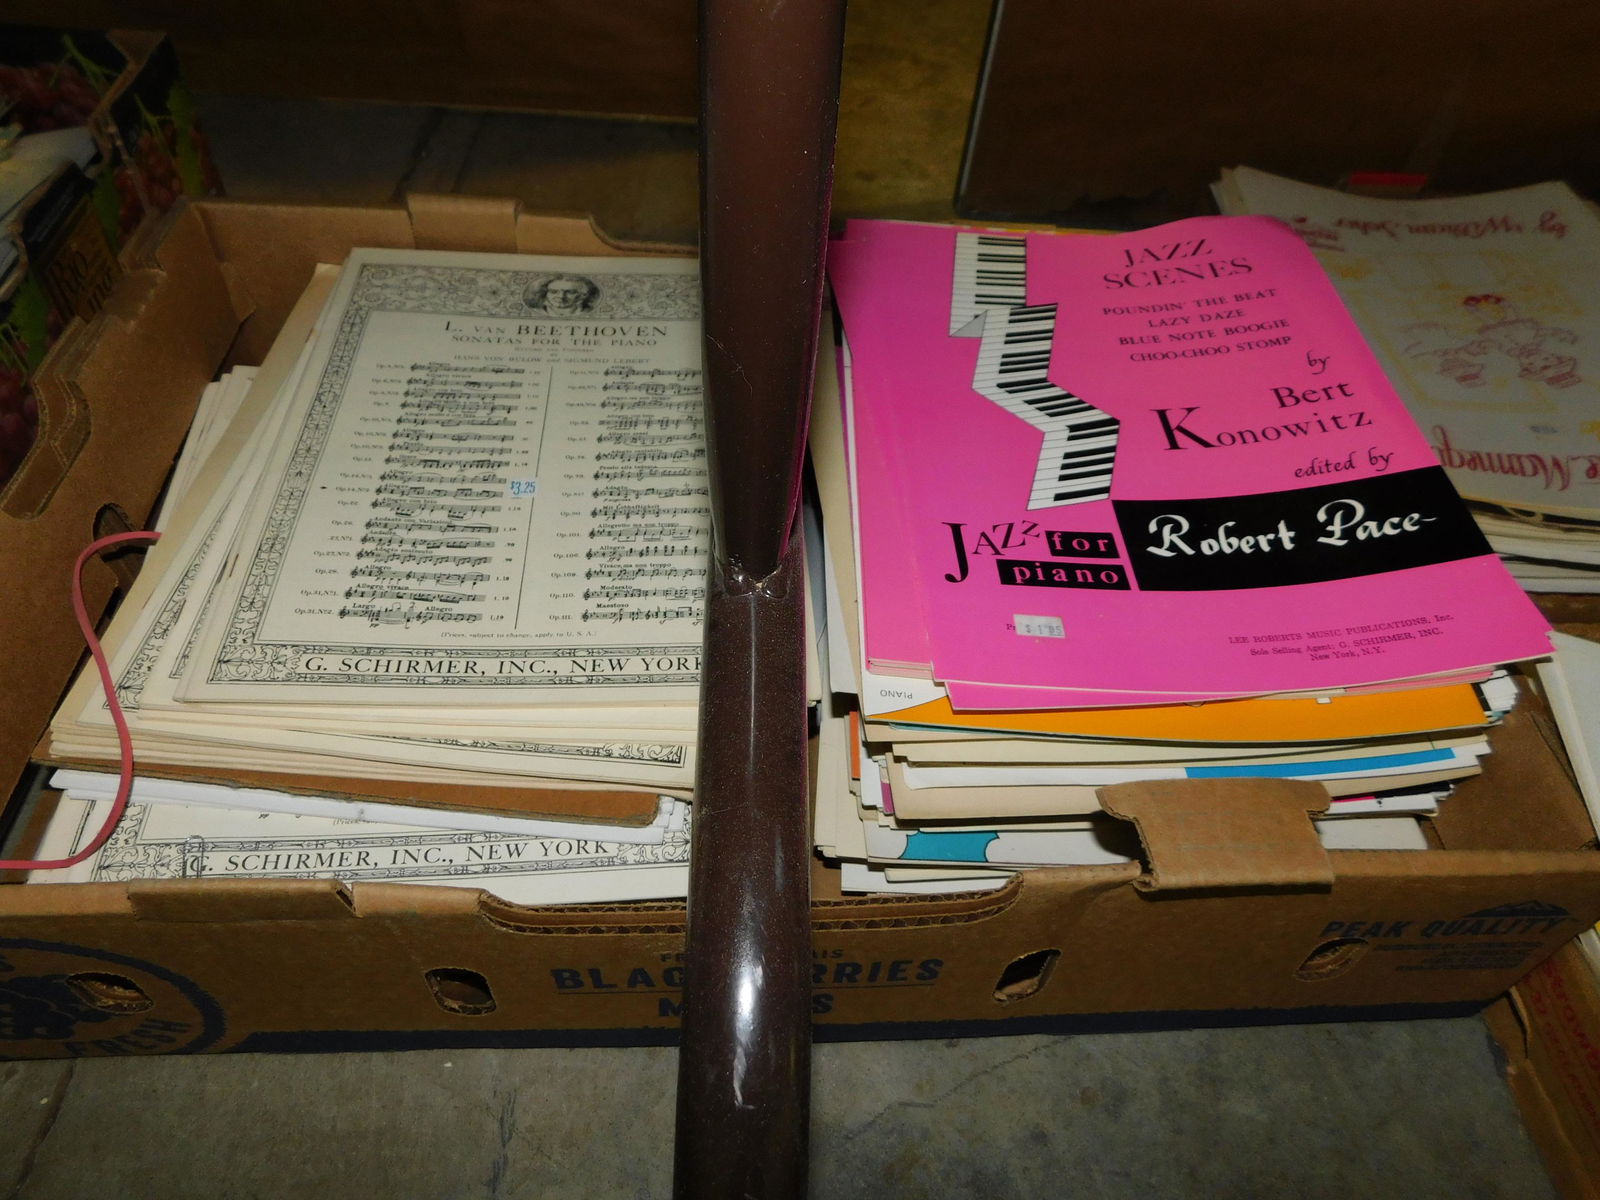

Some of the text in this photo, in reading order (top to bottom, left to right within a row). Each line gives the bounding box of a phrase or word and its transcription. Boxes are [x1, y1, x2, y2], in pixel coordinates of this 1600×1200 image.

[1121, 238, 1214, 268] JAZZ
[1103, 256, 1253, 289] SCENES
[1193, 296, 1226, 308] THE
[1234, 288, 1279, 303] BEAT
[473, 325, 506, 335] VAN
[516, 324, 668, 338] BEETHOVEN
[1148, 309, 1245, 328] LAZY DAZE
[449, 333, 658, 349] SONATAS FOR THE PIANO
[1119, 319, 1290, 346] BLUE NOTE BOOGIE
[1129, 335, 1292, 362] CHOO-CHOO STOMP
[1306, 350, 1330, 375] by
[1270, 382, 1355, 409] Bert
[1150, 406, 1373, 451] Konowitz
[1294, 446, 1394, 479] edited by
[509, 480, 536, 496] $3.25
[1051, 531, 1111, 554] for
[1146, 513, 1298, 559] Robert
[1011, 562, 1120, 586] piano
[1228, 636, 1250, 645] LEE
[1253, 632, 1304, 644] ROBERTS
[1305, 628, 1342, 640] MUSIC
[1434, 612, 1454, 624] Inc.
[1249, 647, 1270, 657] Sole
[1272, 644, 1302, 656] Selling
[1418, 626, 1444, 639] INC.
[304, 656, 329, 673] G.
[339, 656, 487, 677] SCHIRMER,
[497, 658, 558, 677] INC.,
[568, 657, 634, 675] NEW
[1311, 651, 1332, 662] New
[1333, 648, 1359, 660] York,
[879, 688, 914, 700] PIANO
[185, 837, 611, 874] G. SCHIRMER, INC., NEW YORK
[1320, 916, 1567, 939] PEAK QUALITY
